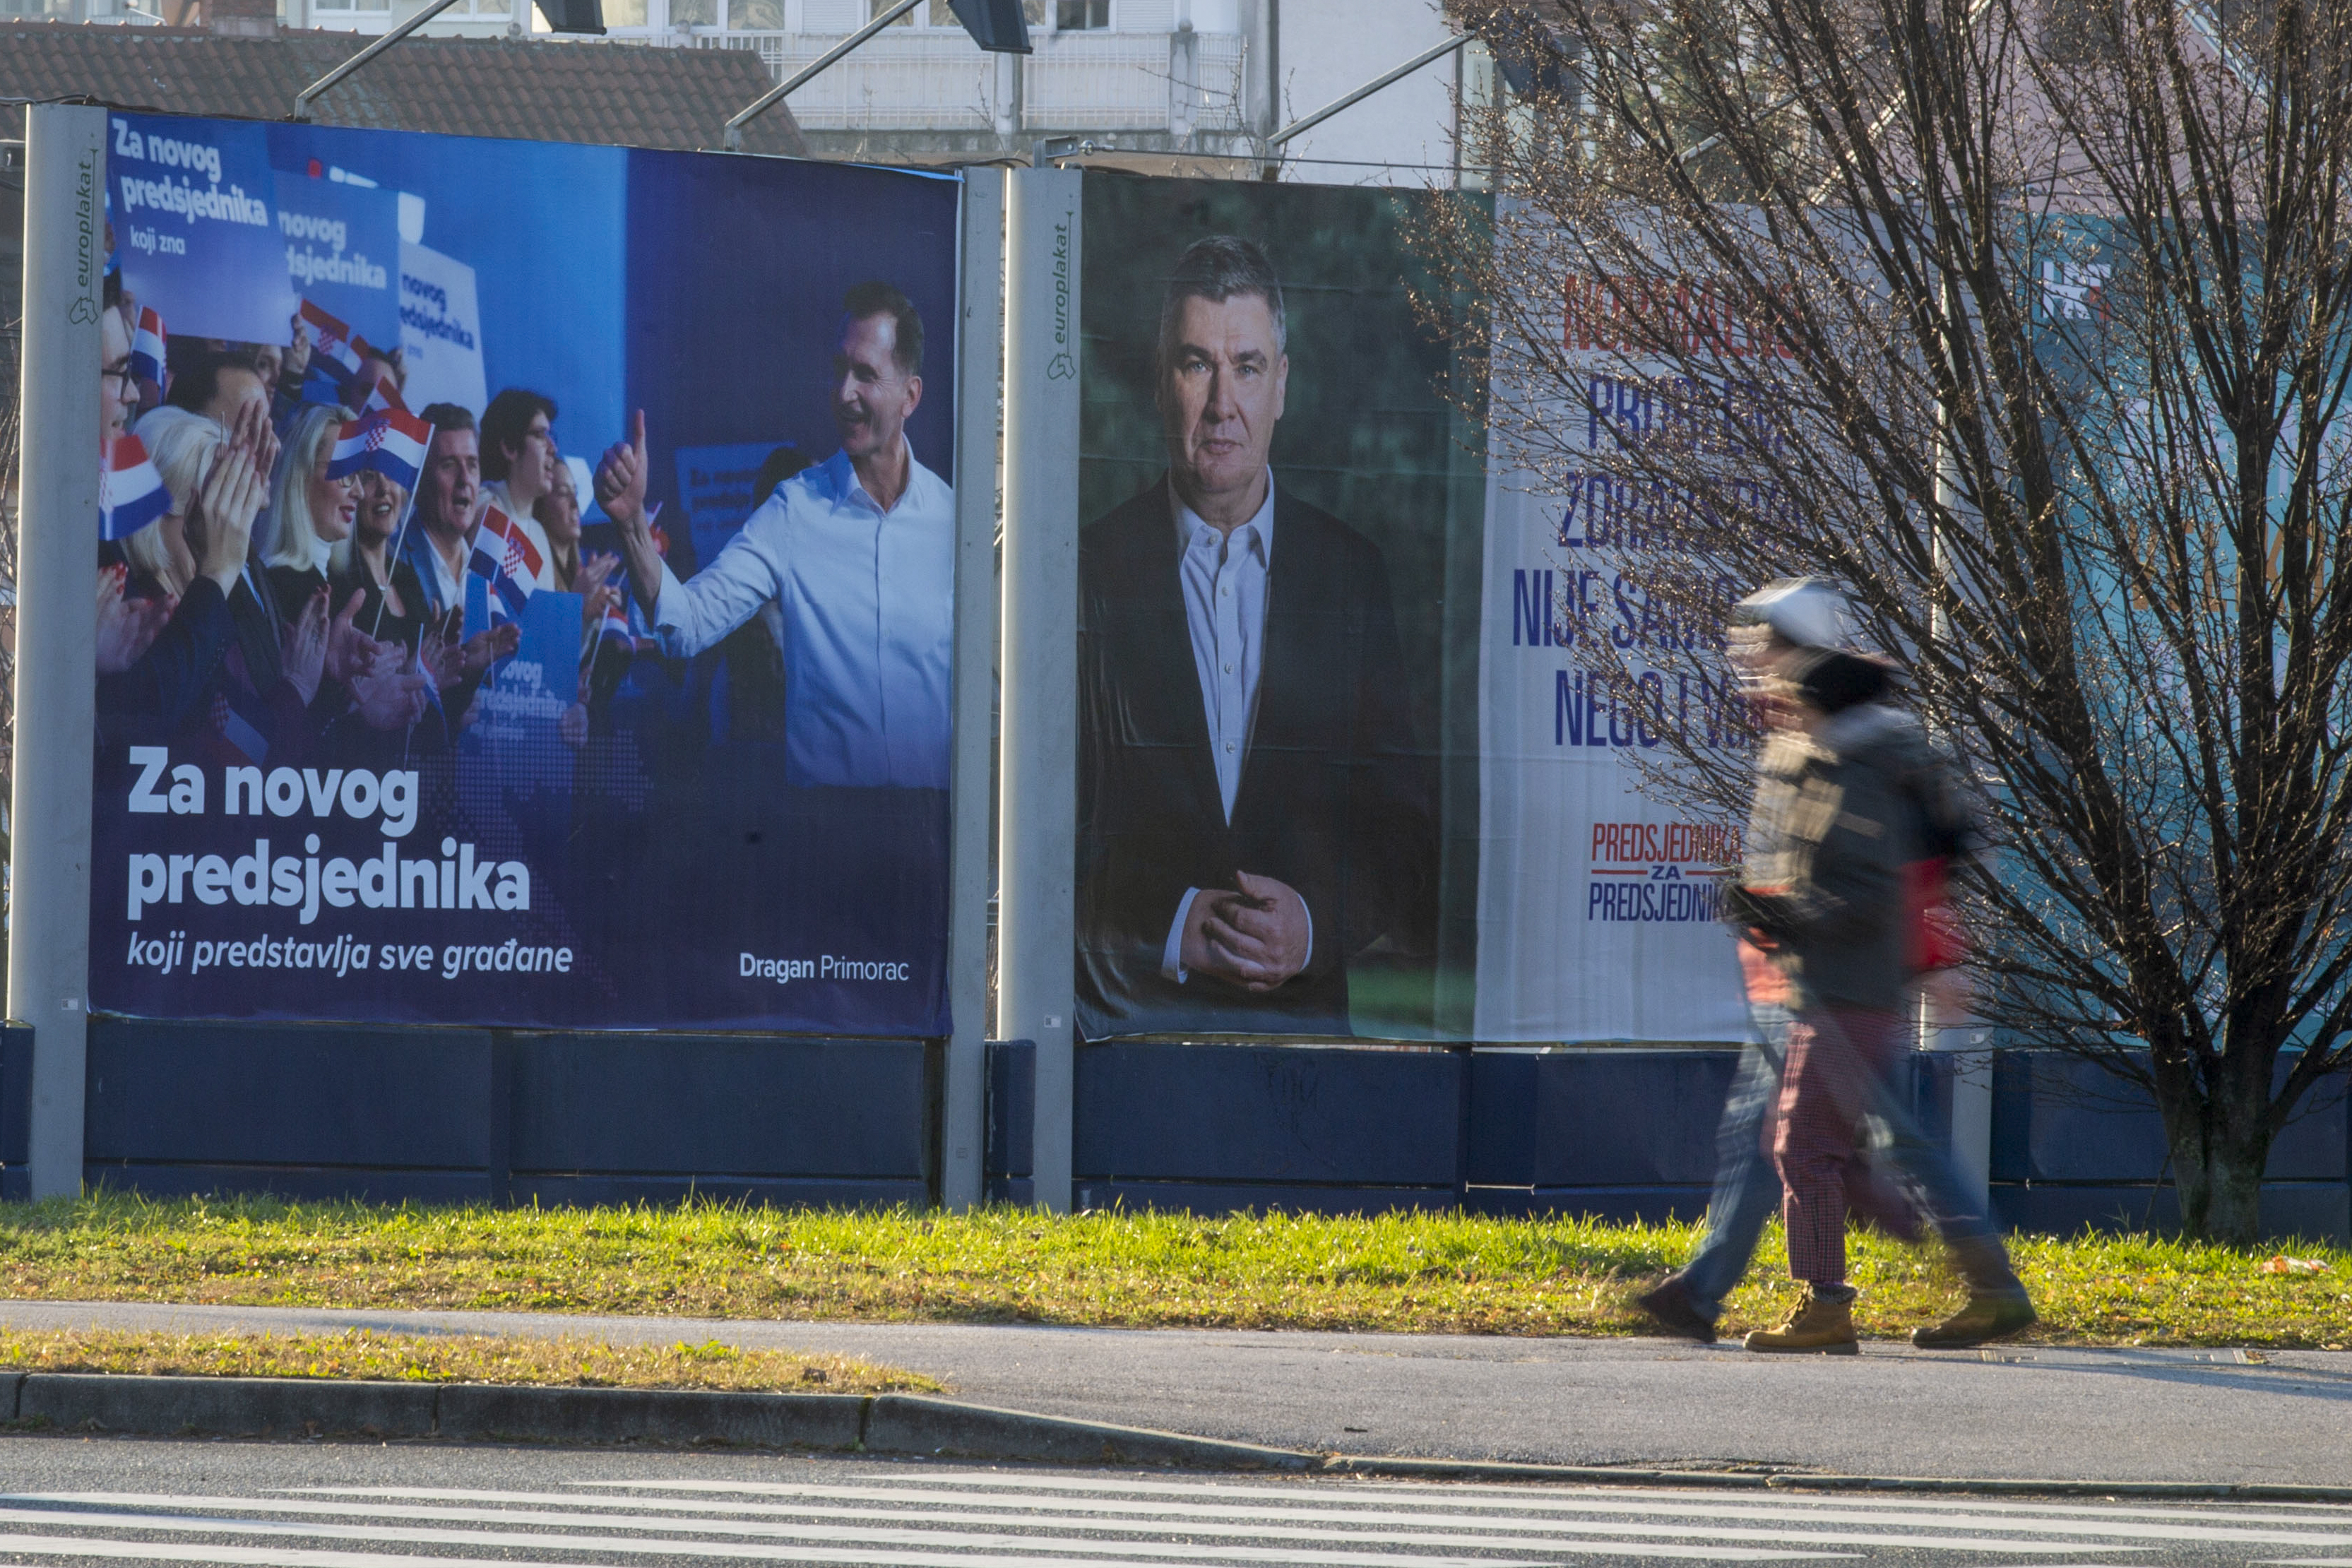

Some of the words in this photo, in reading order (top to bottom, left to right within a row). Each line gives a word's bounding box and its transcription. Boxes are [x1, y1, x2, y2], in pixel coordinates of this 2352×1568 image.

[112, 118, 144, 160] Za
[148, 134, 222, 184] novog
[76, 161, 93, 287] europlakat
[120, 174, 268, 227] predsjednika
[130, 225, 156, 256] koji
[159, 234, 186, 255] zna
[1052, 223, 1070, 344] europlakat
[1513, 569, 1599, 648] NIJE
[1555, 670, 1663, 747] NEGO
[129, 745, 206, 815] Za
[225, 766, 420, 838] novog
[1592, 823, 1742, 863] PREDSJEDNIKA
[1651, 865, 1682, 881] ZA
[127, 833, 530, 925] predsjednika
[126, 930, 186, 975] koji
[191, 933, 372, 978] predstavlja
[379, 944, 434, 971] sve
[441, 937, 574, 980] građane
[740, 952, 815, 985] Dragan
[820, 954, 910, 981] Primorac
